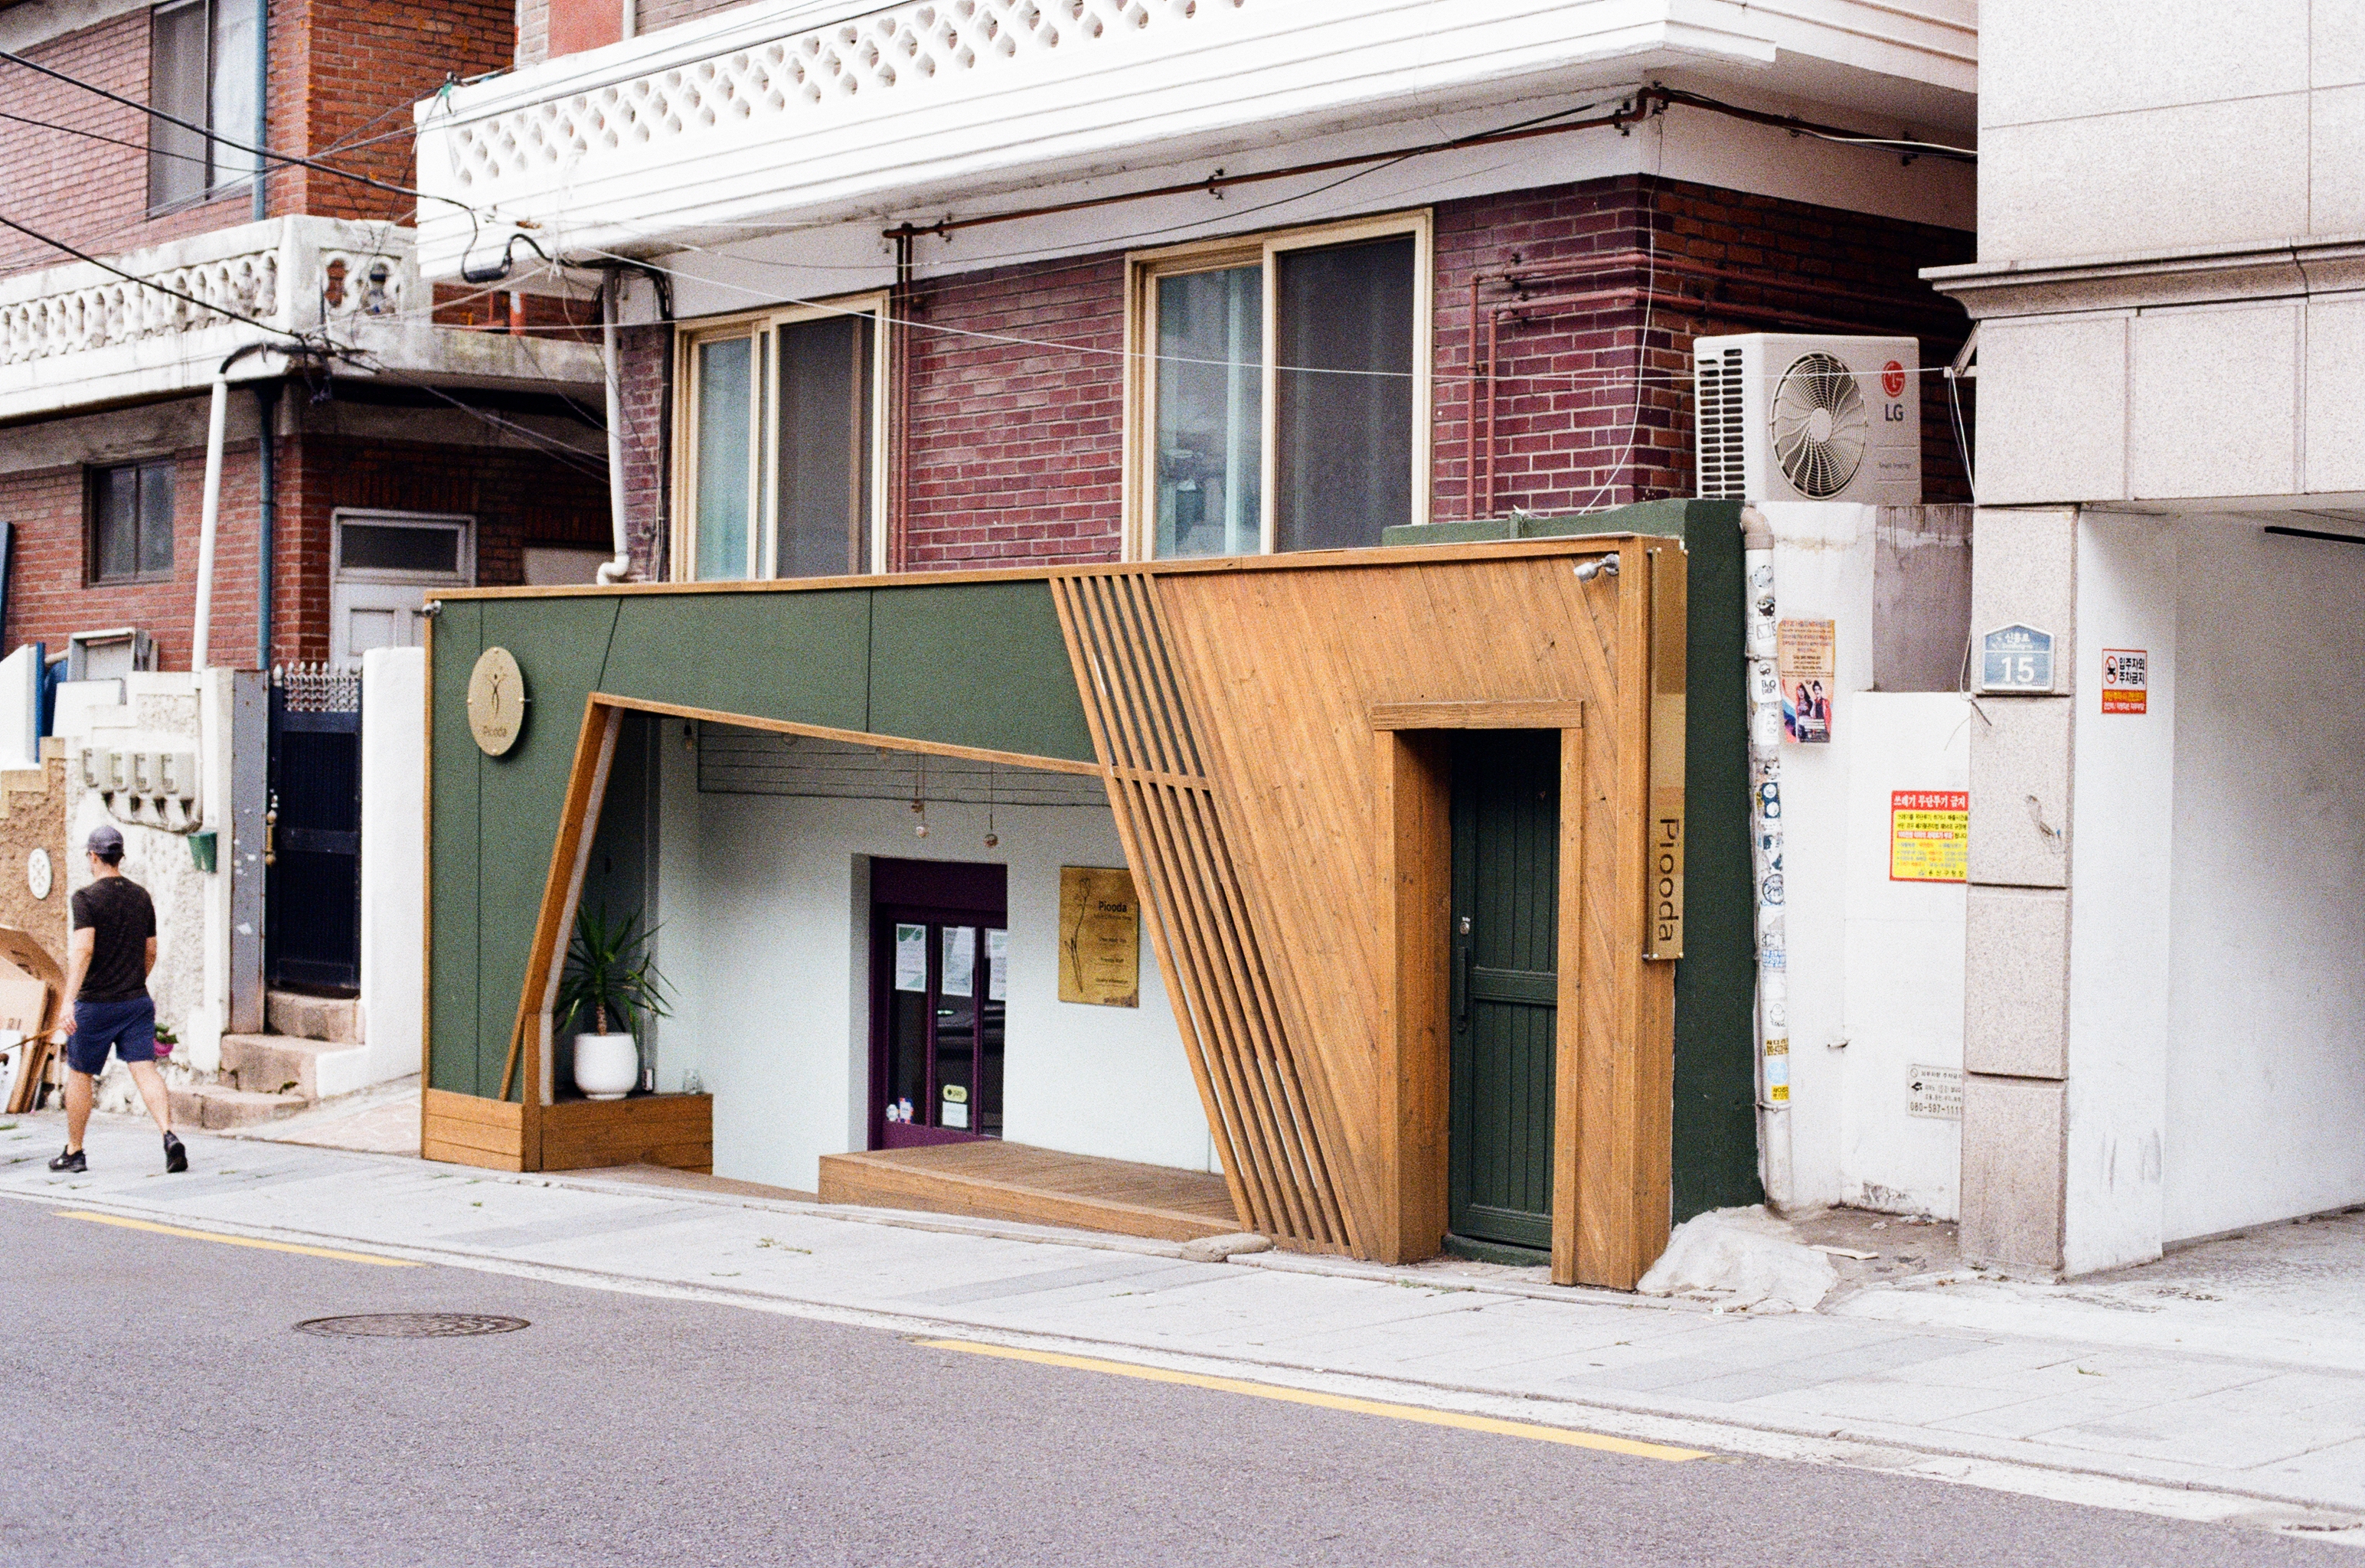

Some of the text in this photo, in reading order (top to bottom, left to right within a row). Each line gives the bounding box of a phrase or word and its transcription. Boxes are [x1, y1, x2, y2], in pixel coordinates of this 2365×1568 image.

[1885, 403, 1904, 422] LG
[2001, 657, 2034, 683] 15
[2119, 657, 2145, 671] 입주자외
[2119, 671, 2145, 685] 주차금지
[1893, 795, 1965, 808] 쓰레기 무단투기 금지
[1658, 818, 1680, 942] Piooda
[1099, 900, 1128, 913] Piooda
